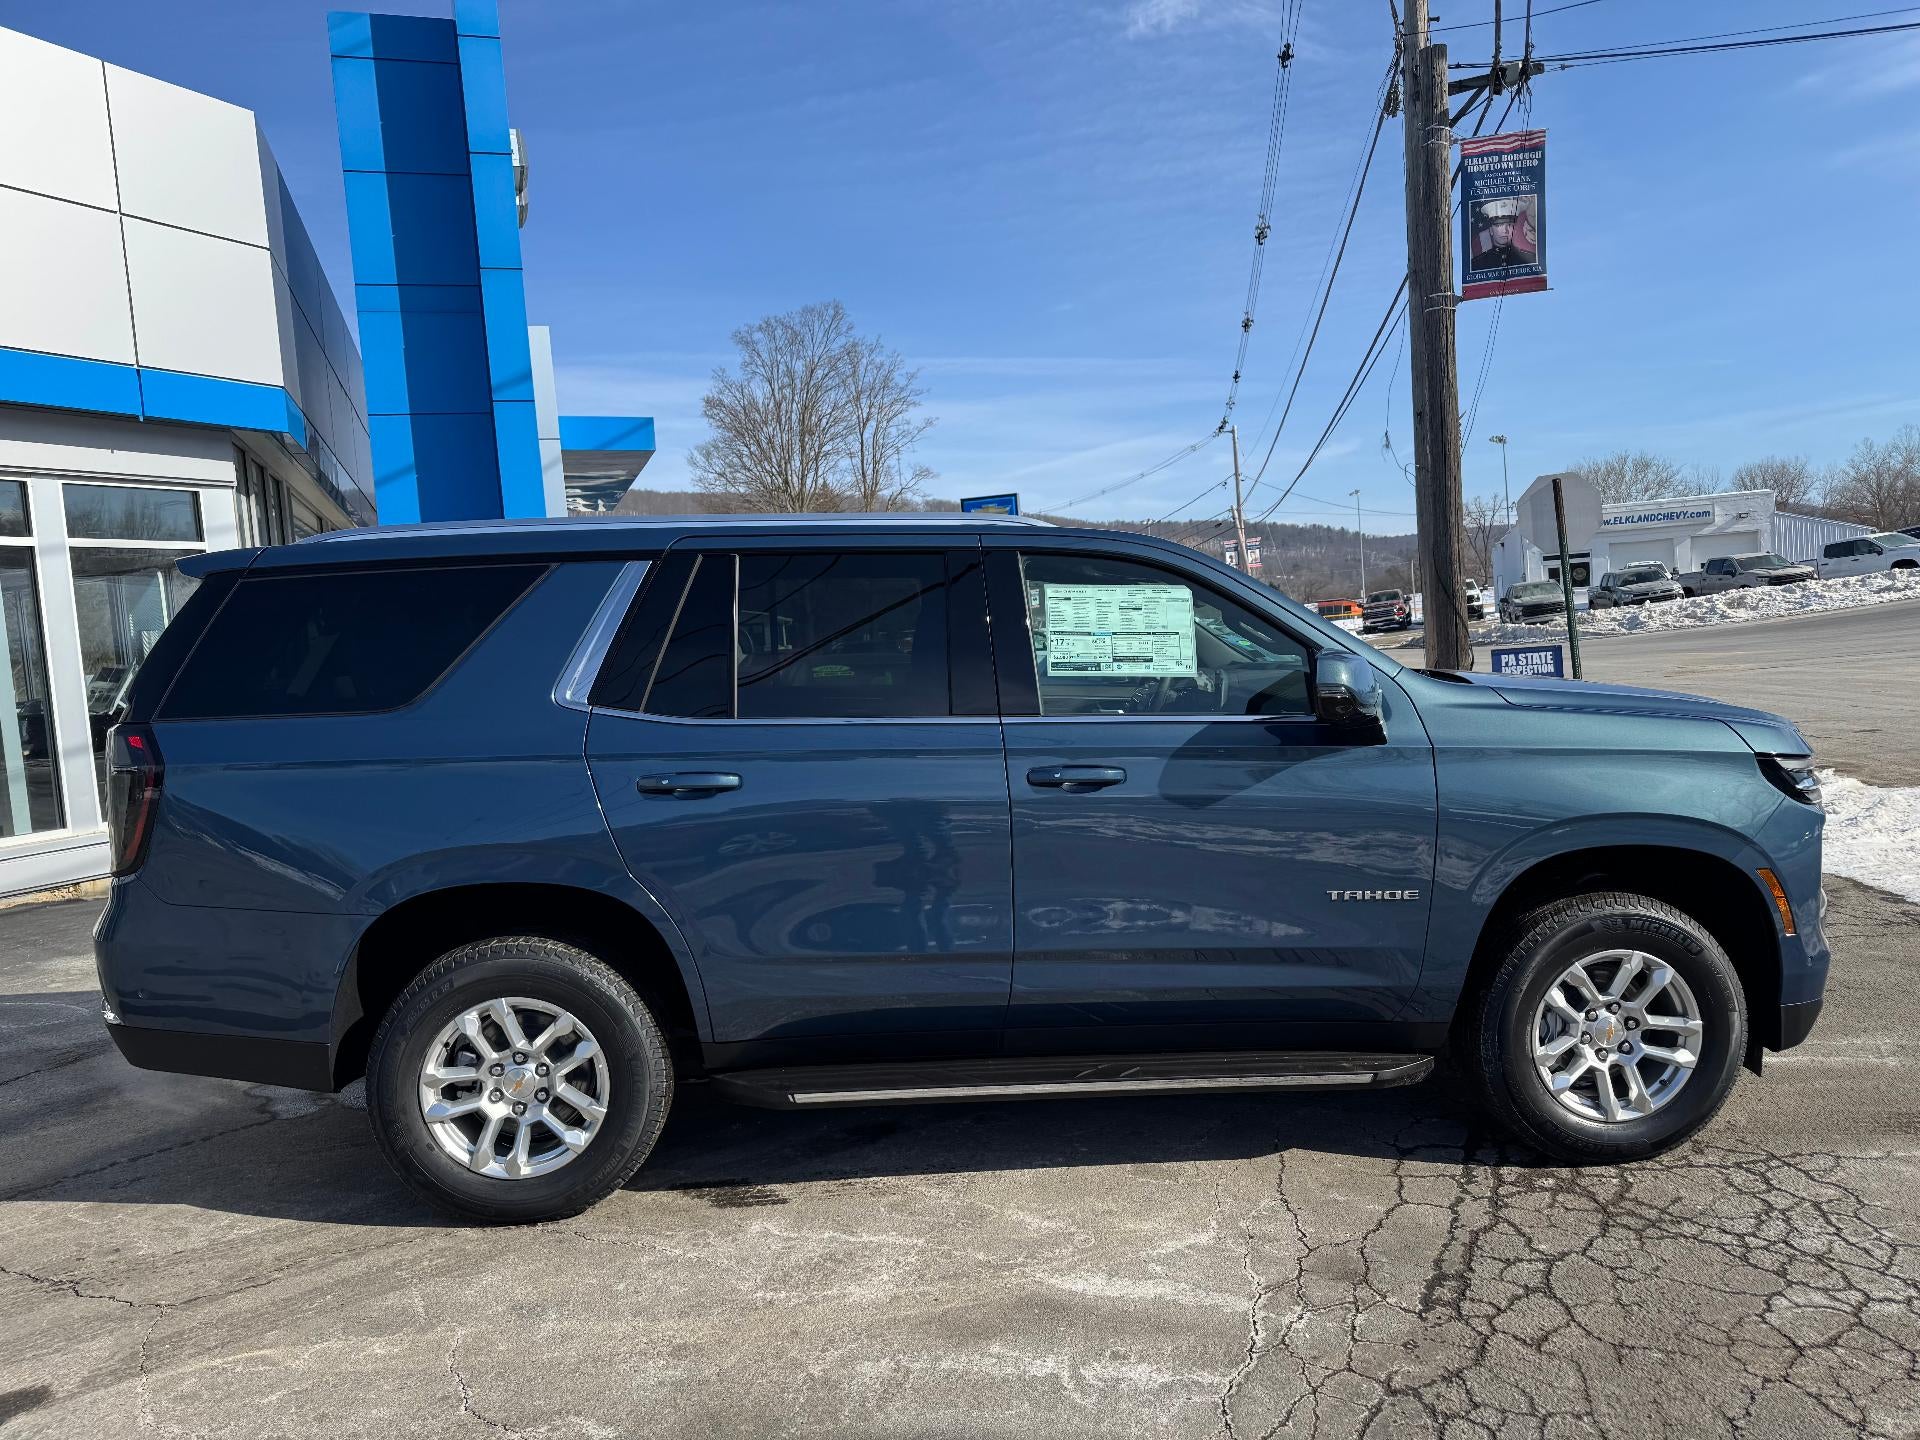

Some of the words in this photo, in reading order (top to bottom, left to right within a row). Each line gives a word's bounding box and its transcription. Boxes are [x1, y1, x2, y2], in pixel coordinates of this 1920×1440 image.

[1464, 155, 1499, 166] ELKLAND
[1501, 151, 1542, 161] BOROUGH
[1467, 161, 1514, 173] HOMETOWN
[1515, 158, 1539, 168] HERO
[1474, 177, 1507, 187] MICHAEL
[1508, 175, 1531, 184] PLANK
[1484, 186, 1512, 194] MARINE
[1513, 182, 1536, 192] CORPS
[1601, 512, 1711, 526] w.ELKLANDCHEVY.com
[1501, 653, 1517, 667] PA
[1518, 650, 1554, 666] STATE
[1502, 663, 1555, 676] INSPECTION
[1326, 888, 1421, 902] TAHOE
[1629, 919, 1701, 952] MICHELIN
